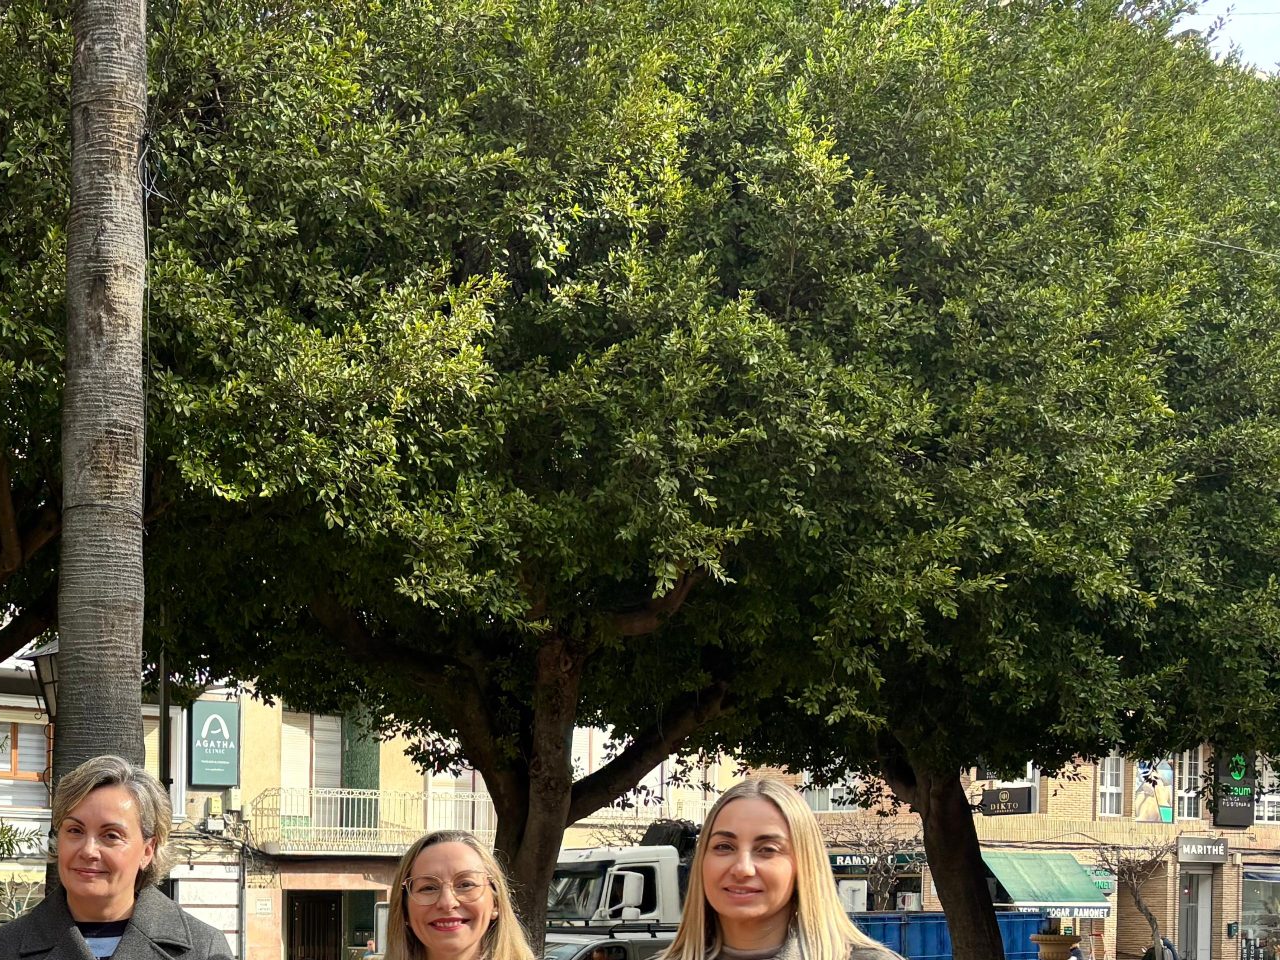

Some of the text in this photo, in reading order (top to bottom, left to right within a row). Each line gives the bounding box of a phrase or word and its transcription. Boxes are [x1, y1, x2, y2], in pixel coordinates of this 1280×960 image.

[195, 740, 235, 749] AGATHA
[990, 802, 1019, 810] DIKTO
[1182, 843, 1225, 855] MARITHÉ
[1073, 908, 1109, 917] RAMONET
